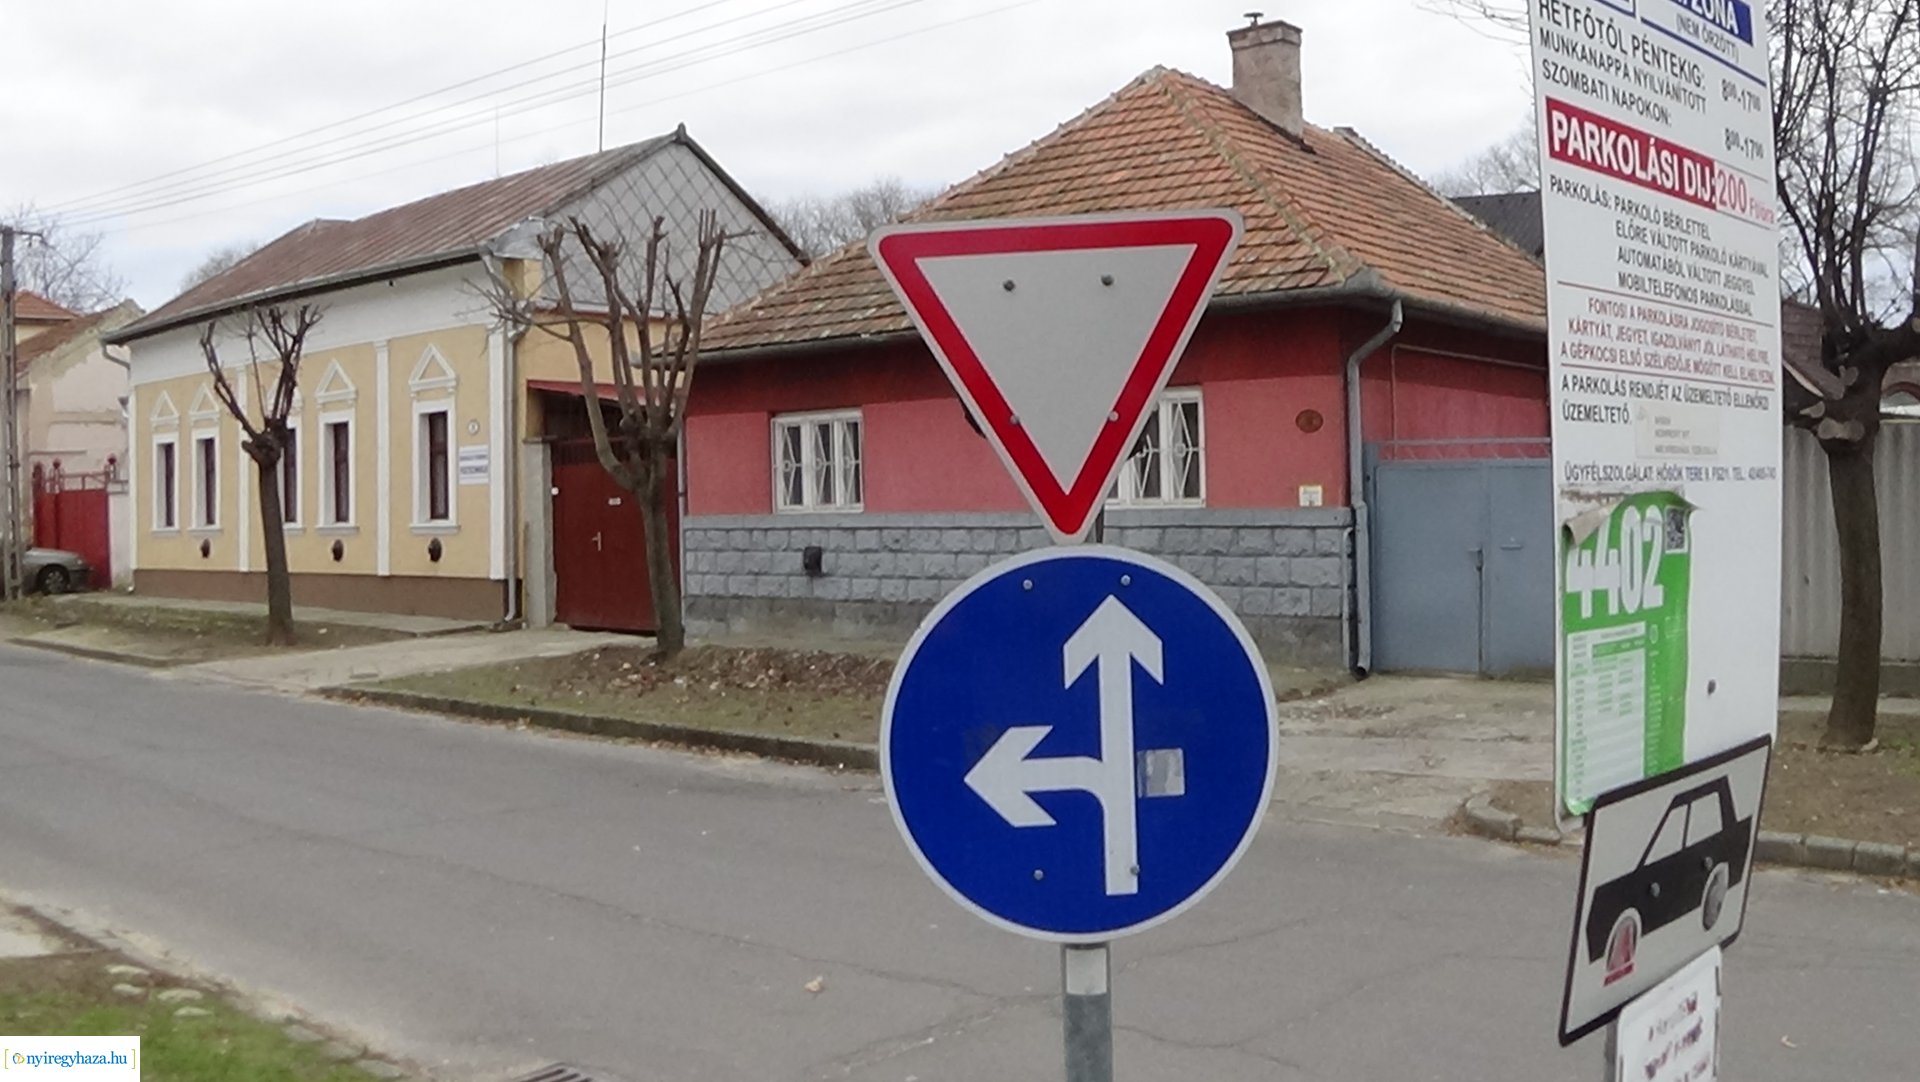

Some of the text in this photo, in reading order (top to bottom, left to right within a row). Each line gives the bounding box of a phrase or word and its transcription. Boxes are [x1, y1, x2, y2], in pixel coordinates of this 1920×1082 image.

[1632, 33, 1706, 91] PÉNTEKIG:
[1542, 58, 1609, 102] SZOMBATI
[1611, 85, 1671, 127] NAPOKON:
[1551, 109, 1679, 192] PARKOLÁSI
[1717, 168, 1747, 215] 200
[1550, 174, 1612, 210] PARKOLÁS:
[1614, 194, 1662, 226] PARKOLÓ
[1629, 304, 1637, 320] A
[1560, 340, 1568, 357] A
[1561, 374, 1569, 392] A
[1571, 374, 1627, 397] PARKOLÁS
[1629, 379, 1669, 401] RENDJÉT
[1671, 385, 1683, 402] AZ
[1566, 504, 1664, 619] 4402
